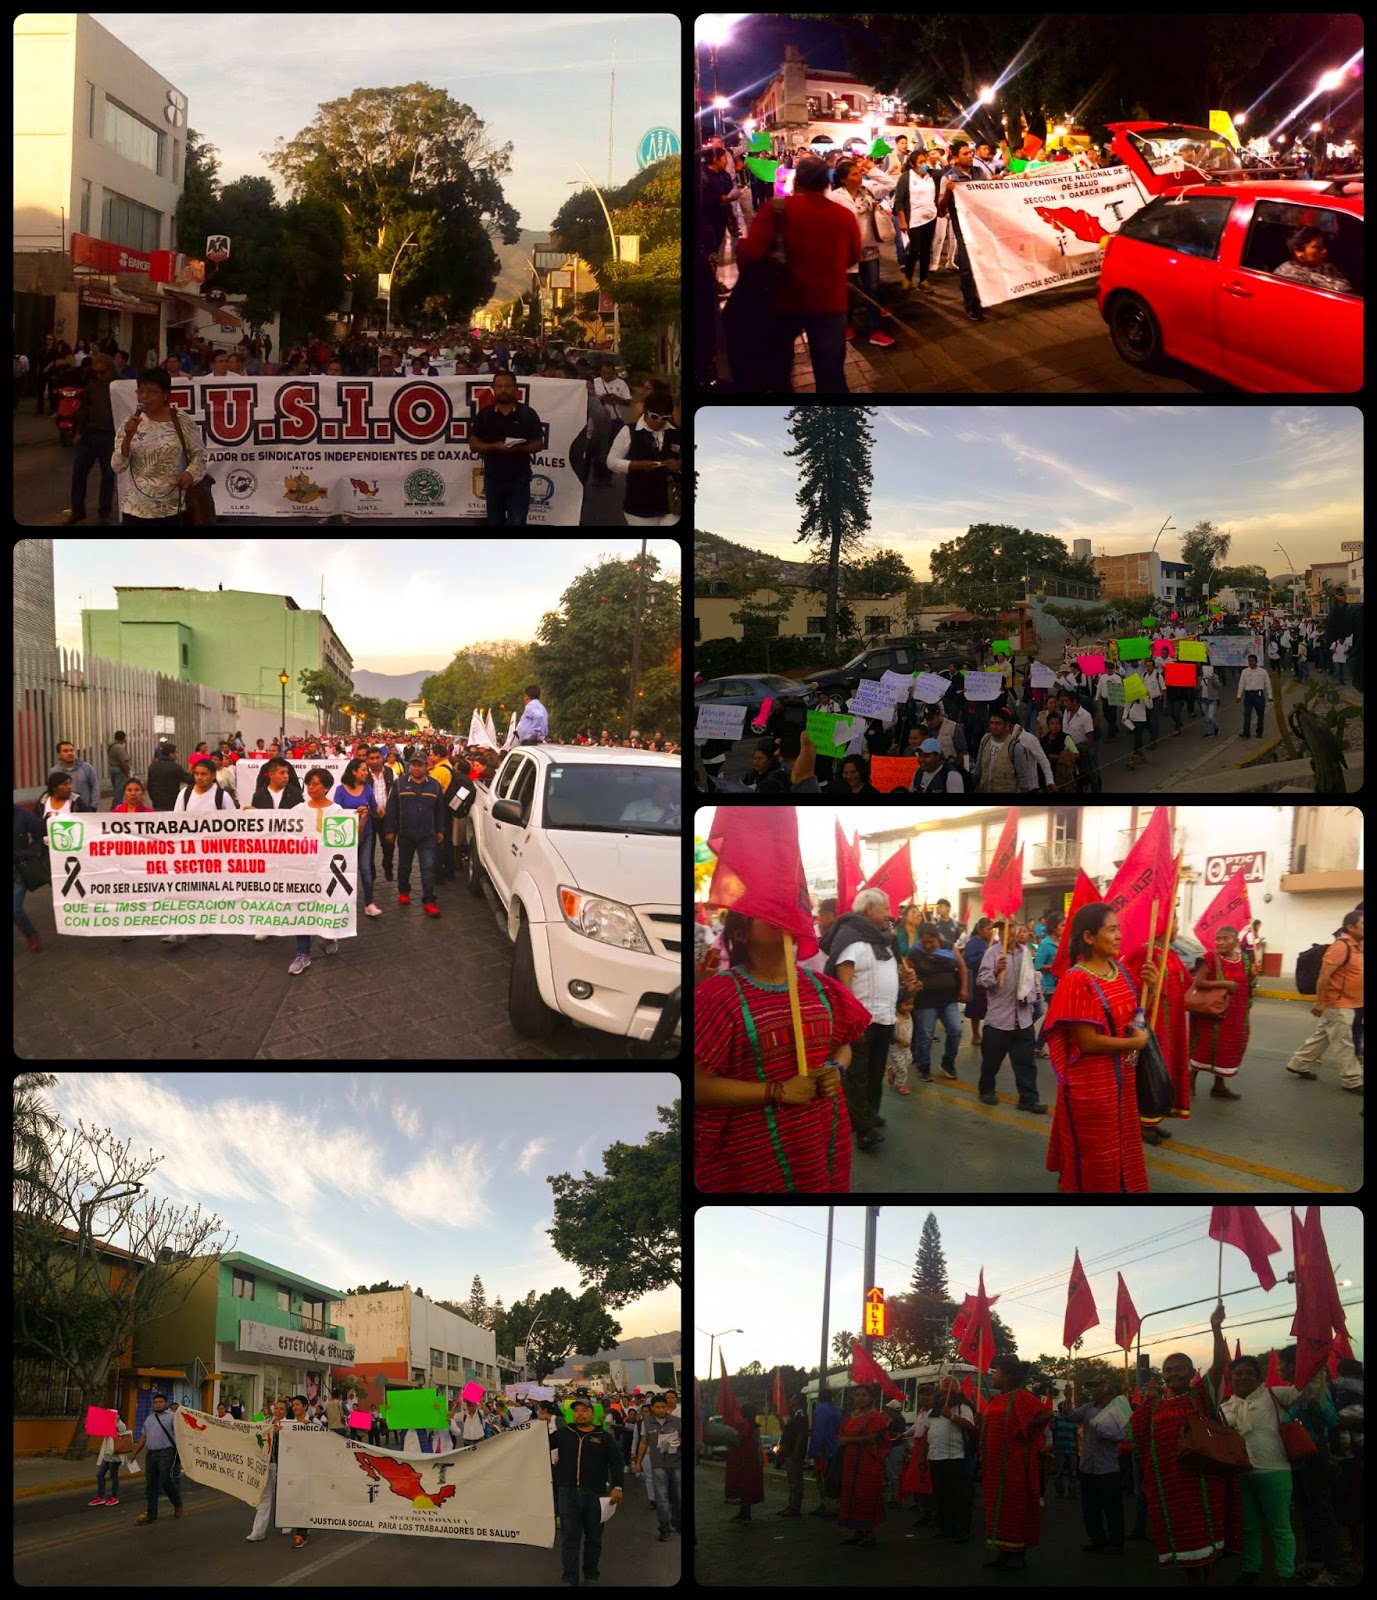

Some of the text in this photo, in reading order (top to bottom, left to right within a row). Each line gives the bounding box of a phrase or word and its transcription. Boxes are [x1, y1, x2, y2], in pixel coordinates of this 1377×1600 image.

[966, 182, 1010, 192] SINDICATO
[1011, 176, 1074, 188] INDEPENDIENTE
[1075, 168, 1112, 182] NACIONAL
[1114, 168, 1123, 177] DE
[1062, 180, 1099, 192] DE SALUD
[1024, 194, 1057, 206] SECCION
[1069, 188, 1100, 200] OAXACA
[1101, 184, 1115, 194] DEL
[1044, 273, 1068, 286] SOCIAL
[1070, 268, 1089, 279] PARA
[1089, 264, 1102, 274] LOS
[205, 450, 566, 469] ADOR DE SINDICATOS INDEPENDIENTES DE OAXACA NALES
[102, 818, 304, 834] LOS TRABAJADORES IMSS
[89, 837, 318, 856] REPUDIAMOS LA UNIVERSALIZACIÓN
[146, 858, 266, 874] DEL SECTOR SALUD
[90, 881, 322, 894] POR SER LESIVA Y CRIMINAL AL PUEBLO DE MEXICO
[63, 898, 350, 915] QUE EL IMSS DELEGACIÓN OAXACA CUMPLA
[64, 914, 349, 929] CON LOS DERECHOS DE LOS TRABAJADORES
[278, 1336, 318, 1356] ESTÉTICA
[247, 1458, 255, 1470] DEL
[432, 1463, 455, 1484] T
[196, 1458, 217, 1472] POPULAR
[226, 1468, 235, 1479] PIE
[237, 1470, 244, 1482] DE
[246, 1473, 260, 1490] LUCHA
[367, 1484, 380, 1504] F
[348, 1519, 374, 1528] SOCIAL
[378, 1522, 397, 1530] PARA
[399, 1523, 413, 1532] LOS
[415, 1524, 474, 1536] TRABAJADORES
[477, 1526, 488, 1537] DE
